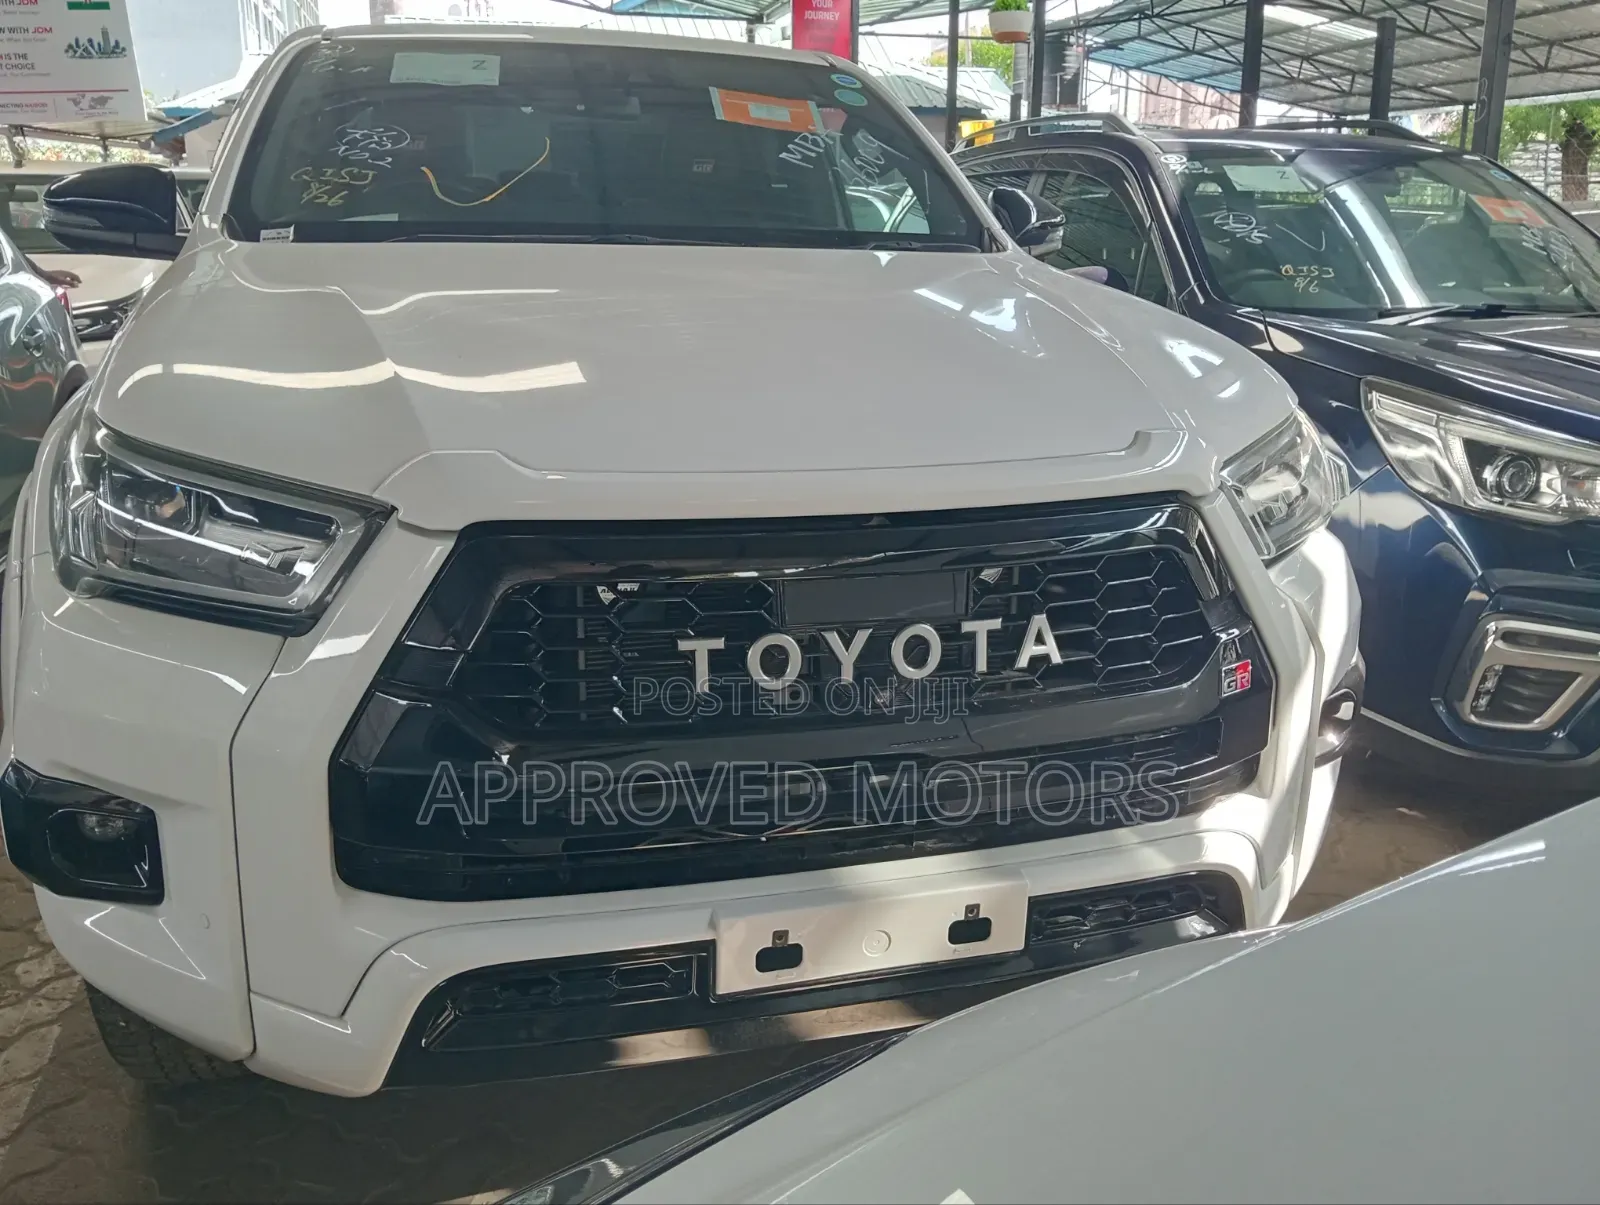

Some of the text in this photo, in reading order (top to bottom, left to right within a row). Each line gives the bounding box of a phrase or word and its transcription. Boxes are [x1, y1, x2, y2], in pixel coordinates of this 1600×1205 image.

[811, 0, 833, 8] YOUR
[804, 10, 840, 21] JOURNEY
[7, 26, 29, 34] WITH
[4, 53, 12, 61] IS
[13, 53, 28, 61] THE
[5, 62, 36, 70] CHOICE
[677, 613, 1063, 694] TOYOTA
